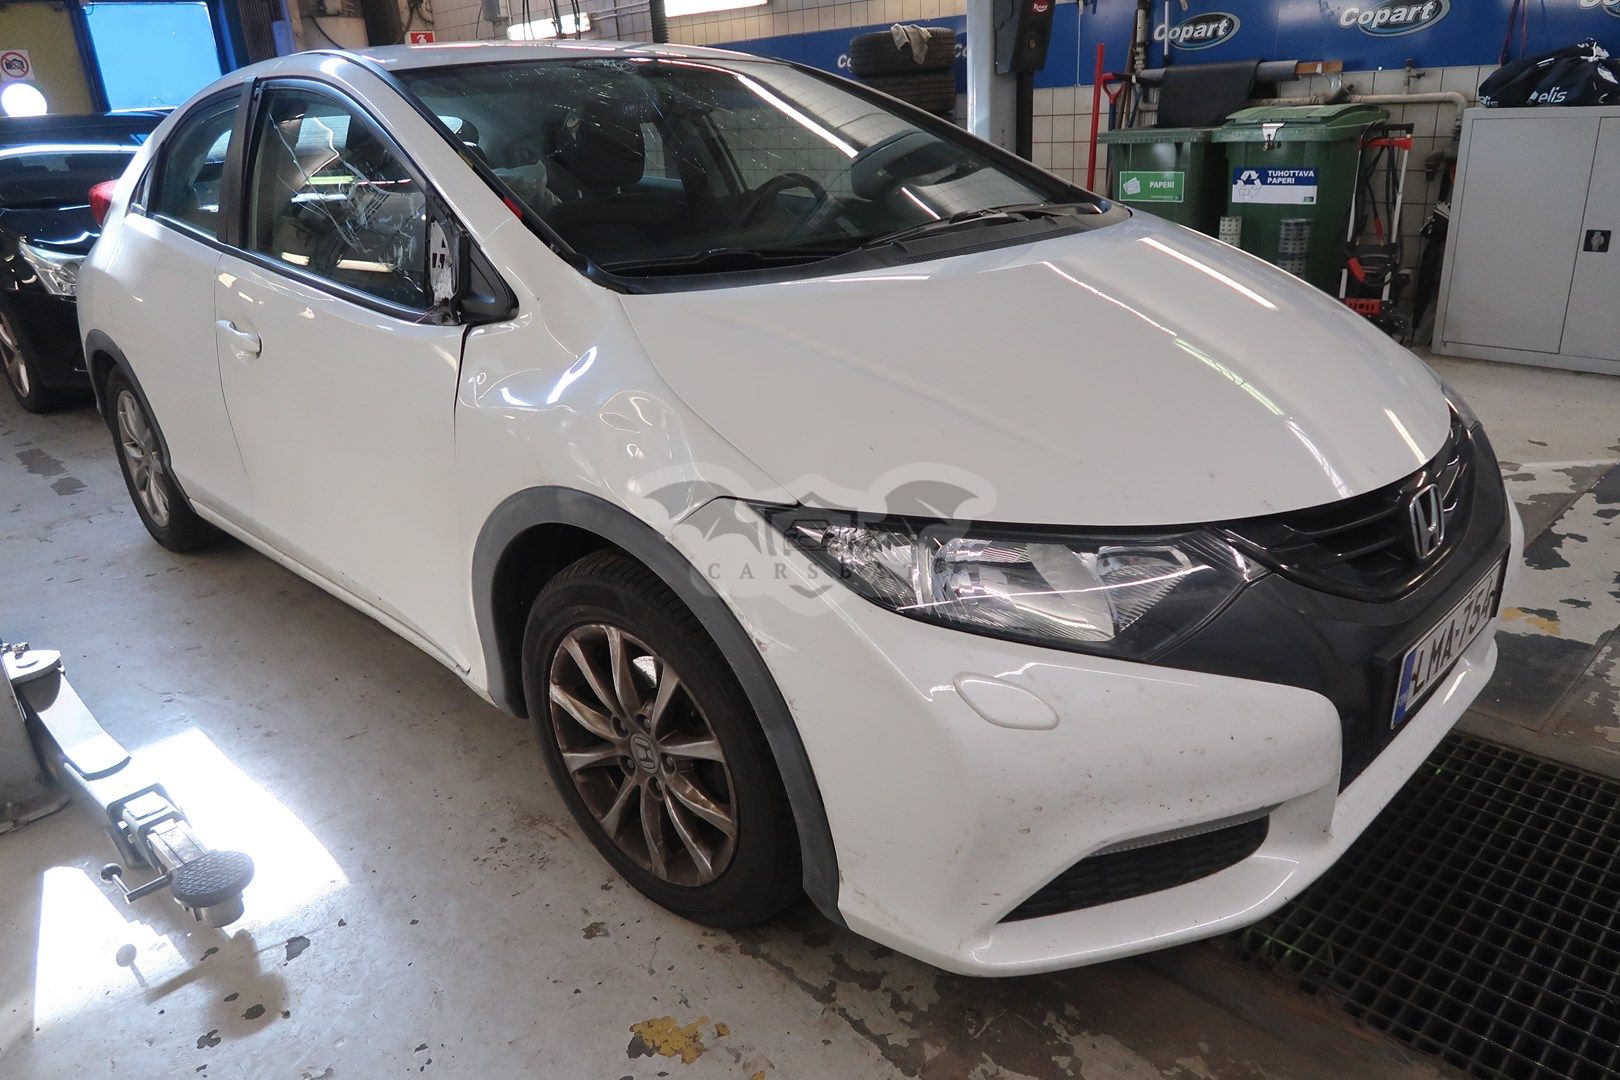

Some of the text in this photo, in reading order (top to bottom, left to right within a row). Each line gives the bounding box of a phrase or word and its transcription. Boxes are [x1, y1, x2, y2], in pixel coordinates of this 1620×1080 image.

[1340, 0, 1434, 29] Copart
[1153, 18, 1228, 43] Copart
[1538, 86, 1568, 103] elis
[1267, 169, 1314, 177] TUHOTTAVA
[1149, 181, 1175, 189] PAPERI
[1411, 578, 1494, 697] LMA-754
